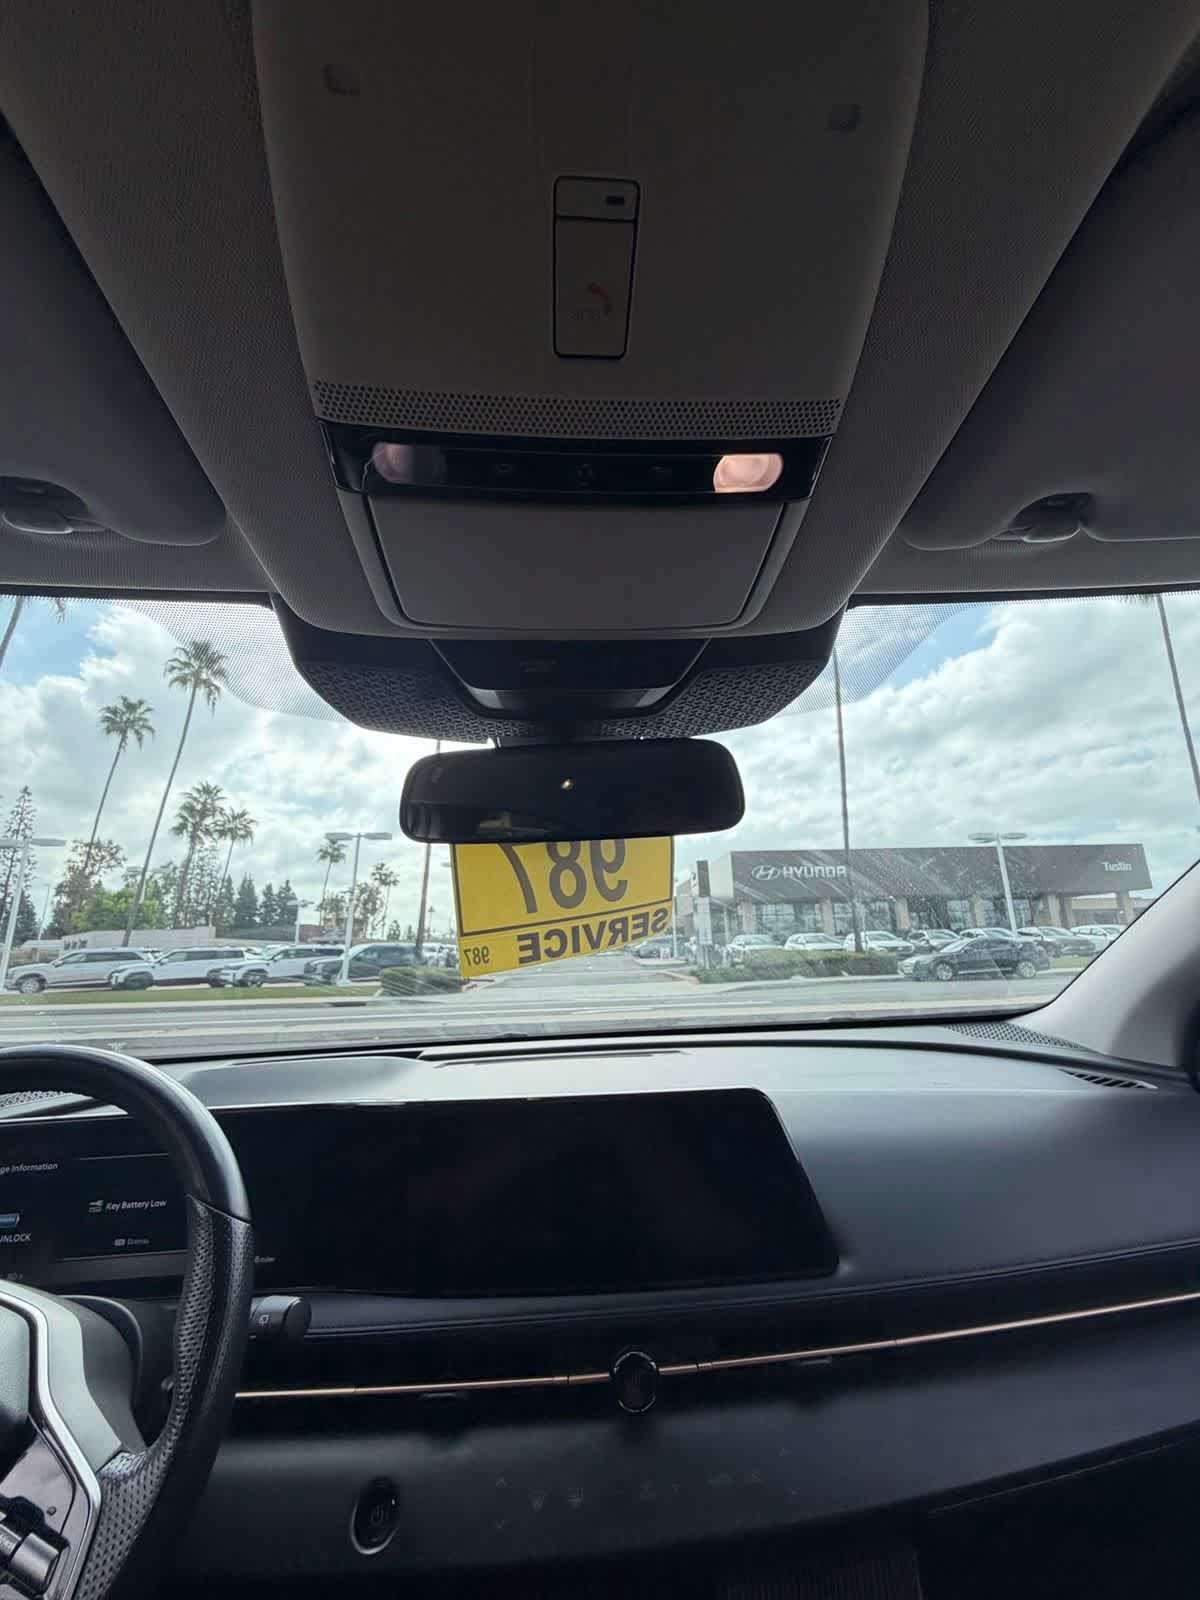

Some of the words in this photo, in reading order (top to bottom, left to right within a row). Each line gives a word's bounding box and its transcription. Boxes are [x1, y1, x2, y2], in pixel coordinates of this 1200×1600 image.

[783, 865, 849, 879] HYUNDA
[1101, 861, 1133, 872] Tustin
[11, 1162, 59, 1173] Information
[105, 1201, 121, 1212] Key
[121, 1200, 150, 1211] Battery
[150, 1199, 168, 1208] Low
